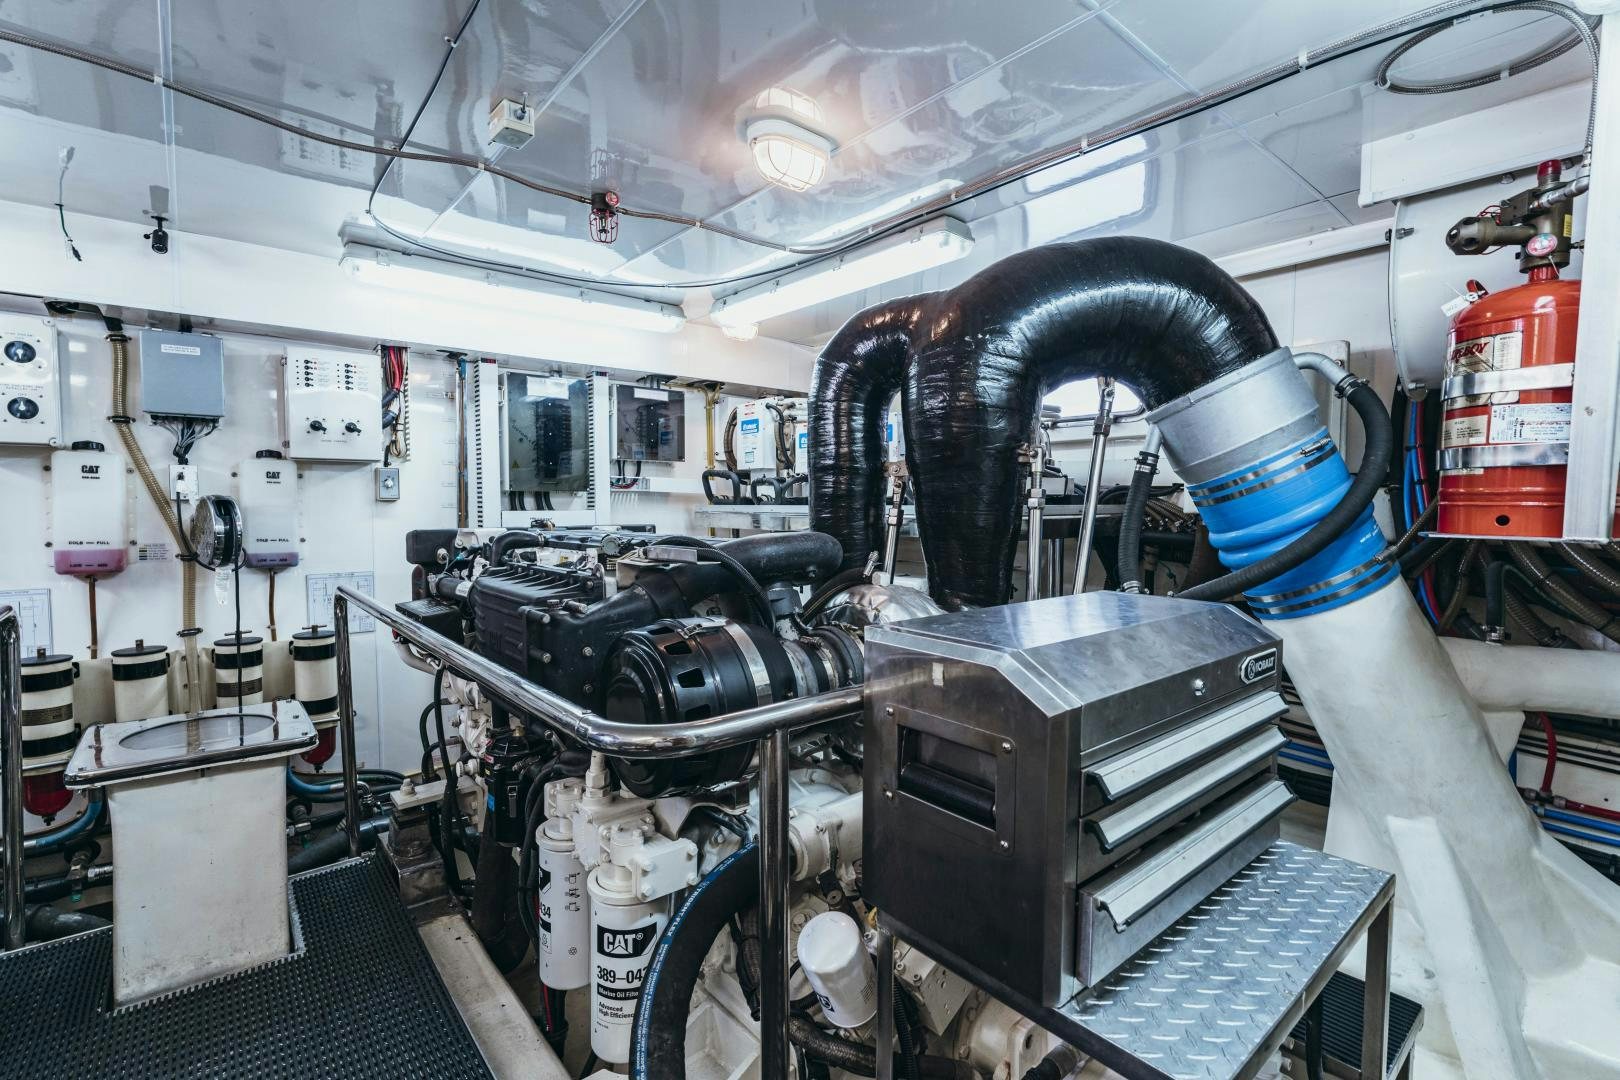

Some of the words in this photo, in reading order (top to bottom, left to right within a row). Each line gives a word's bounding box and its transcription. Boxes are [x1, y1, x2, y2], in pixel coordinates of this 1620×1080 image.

[81, 465, 100, 474] CAT
[266, 471, 281, 479] CAT
[597, 965, 648, 983] 389-04
[599, 1002, 623, 1012] Advanced
